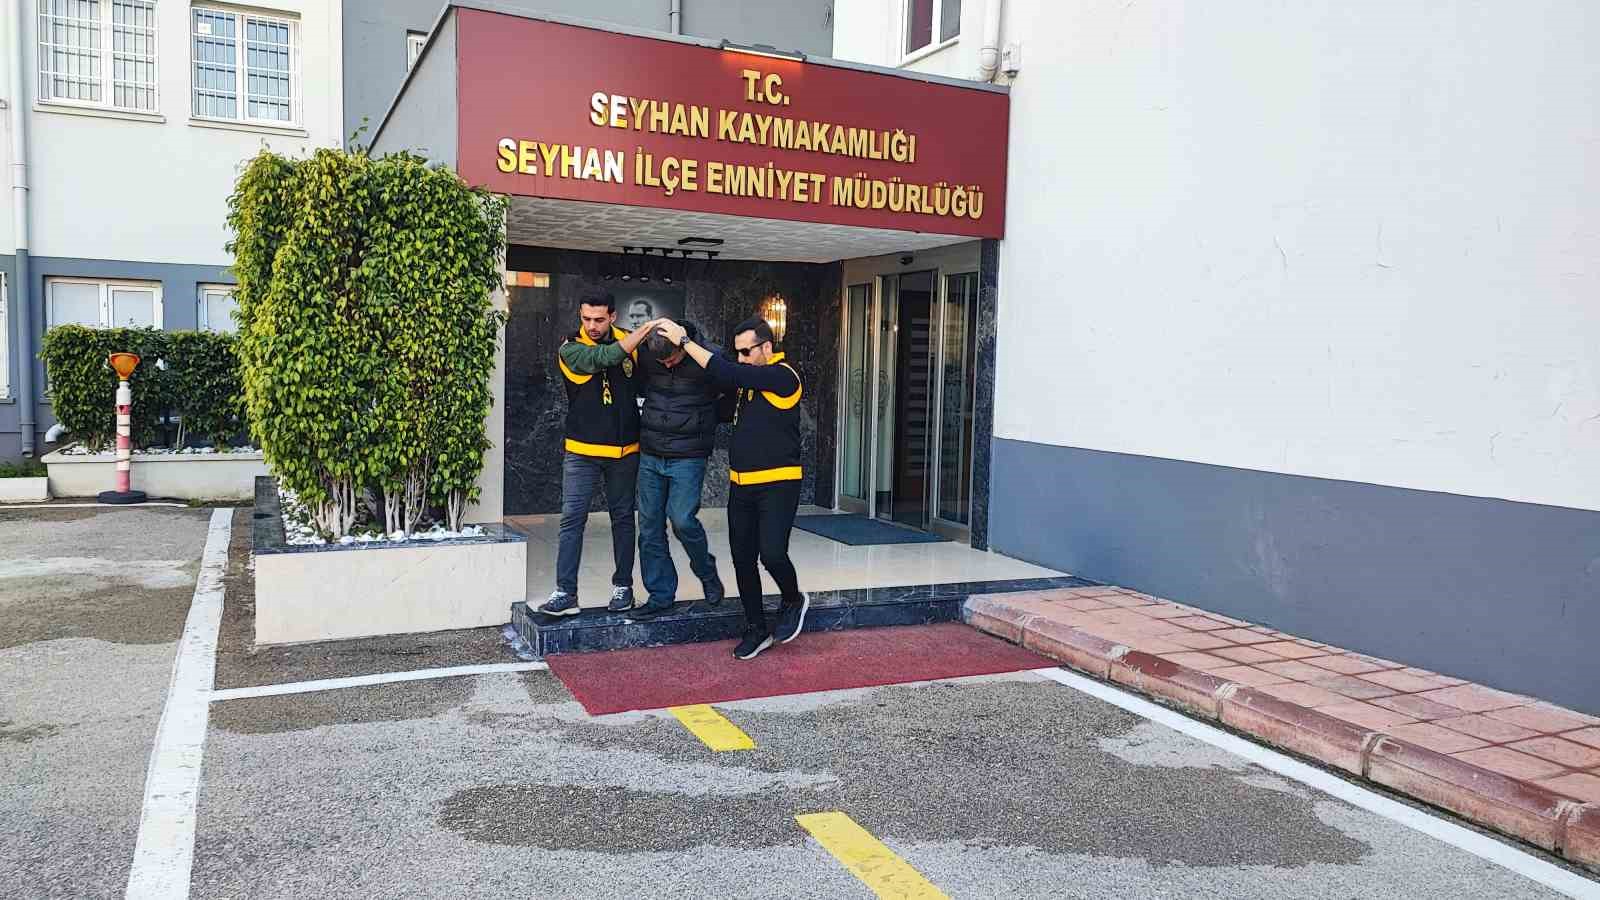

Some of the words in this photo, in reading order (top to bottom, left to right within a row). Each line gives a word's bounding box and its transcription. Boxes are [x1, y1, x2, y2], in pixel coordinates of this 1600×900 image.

[742, 69, 790, 105] T.C.
[591, 92, 709, 138] SEYHAN
[719, 109, 916, 163] KAYMAKAMLIĞI
[497, 137, 624, 184] SEYHAN
[635, 146, 698, 196] İLÇE
[707, 161, 826, 203] EMNİYET
[833, 171, 984, 219] MÜDÜRLÜĞÜ
